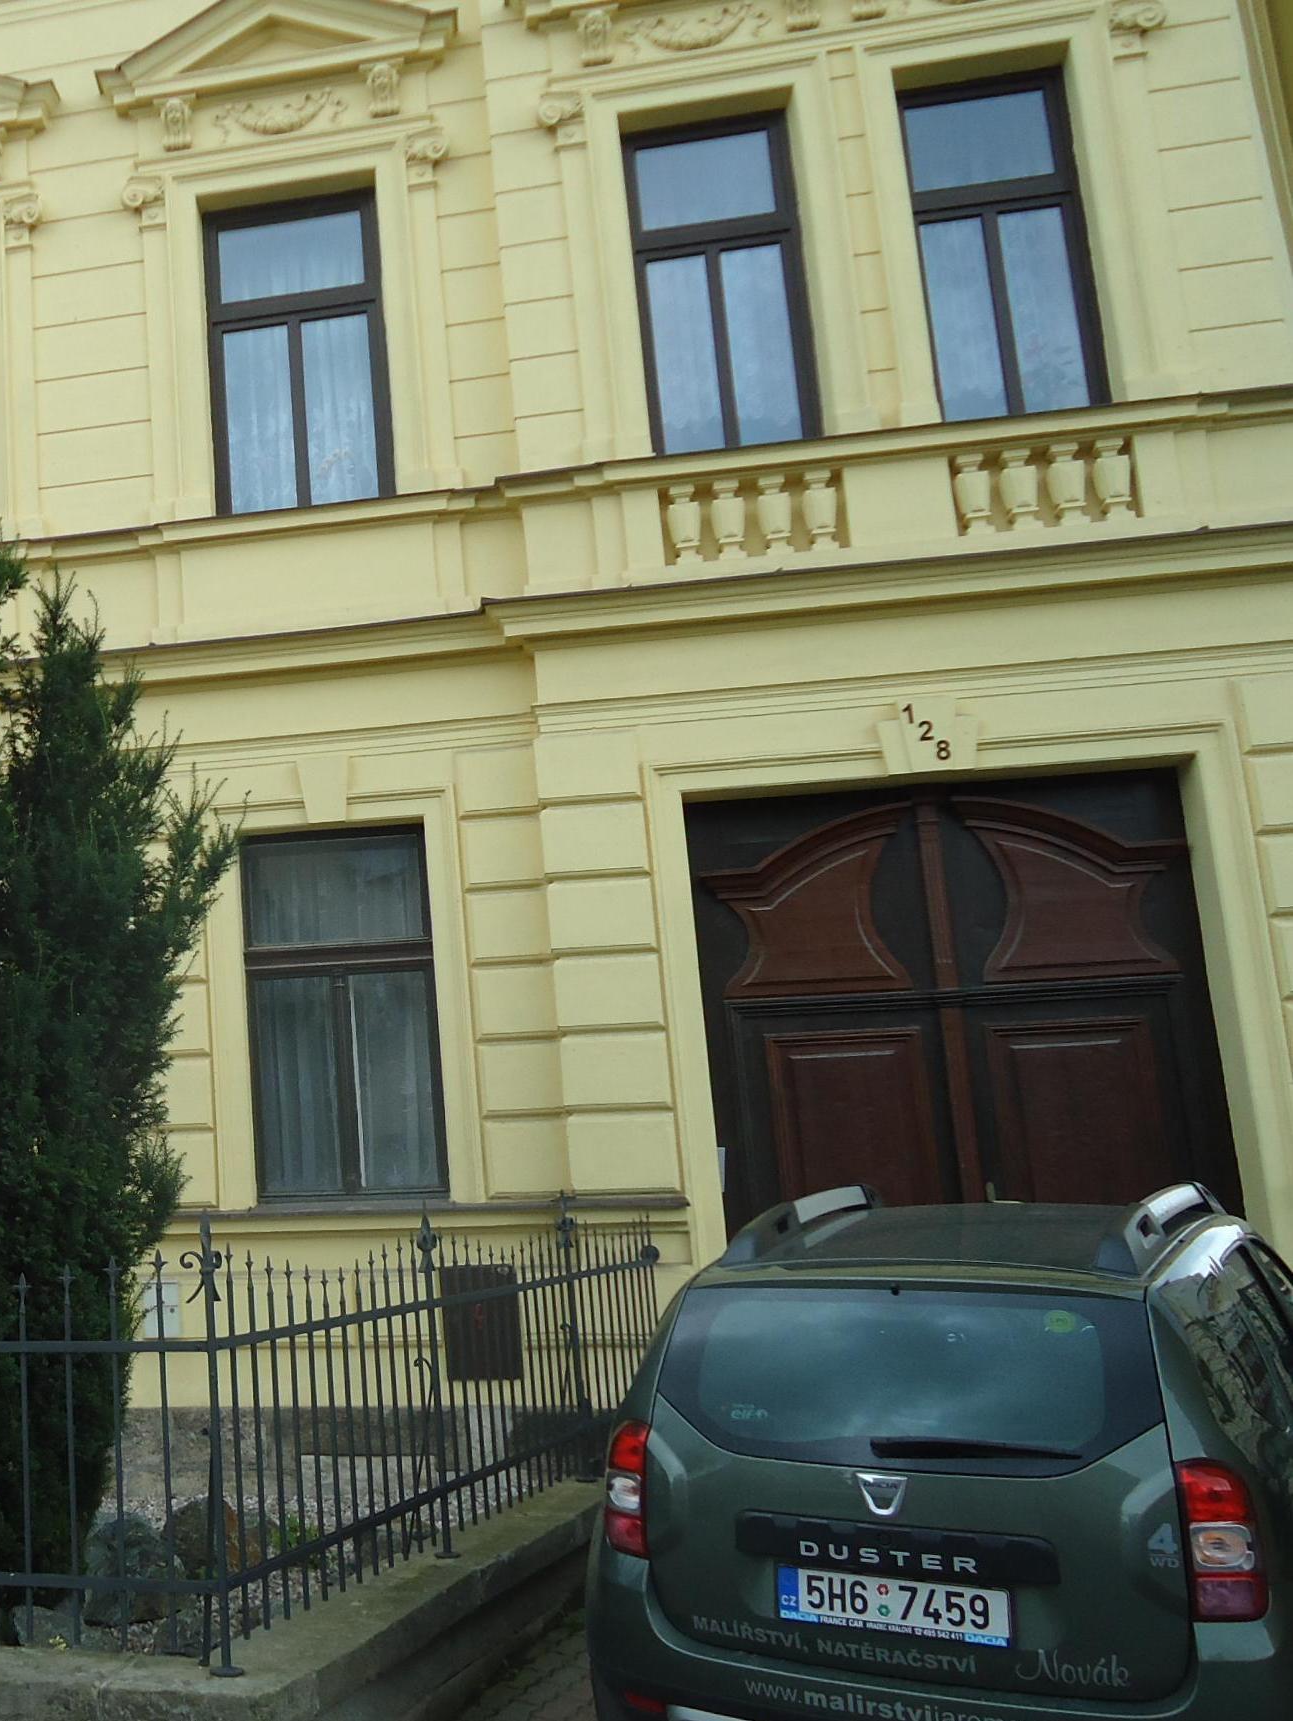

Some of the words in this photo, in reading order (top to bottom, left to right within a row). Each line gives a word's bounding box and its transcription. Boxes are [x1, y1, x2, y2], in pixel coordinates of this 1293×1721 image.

[902, 703, 951, 760] 128
[799, 1540, 978, 1574] DUSTER
[780, 1610, 818, 1622] DACIA
[781, 1594, 797, 1607] CZ
[806, 1574, 869, 1615] 5H6
[897, 1584, 990, 1630] 7459
[817, 1637, 977, 1674] NATĚRAČSTVÍ
[966, 1633, 1007, 1647] DACIA
[1014, 1648, 1129, 1687] Novák
